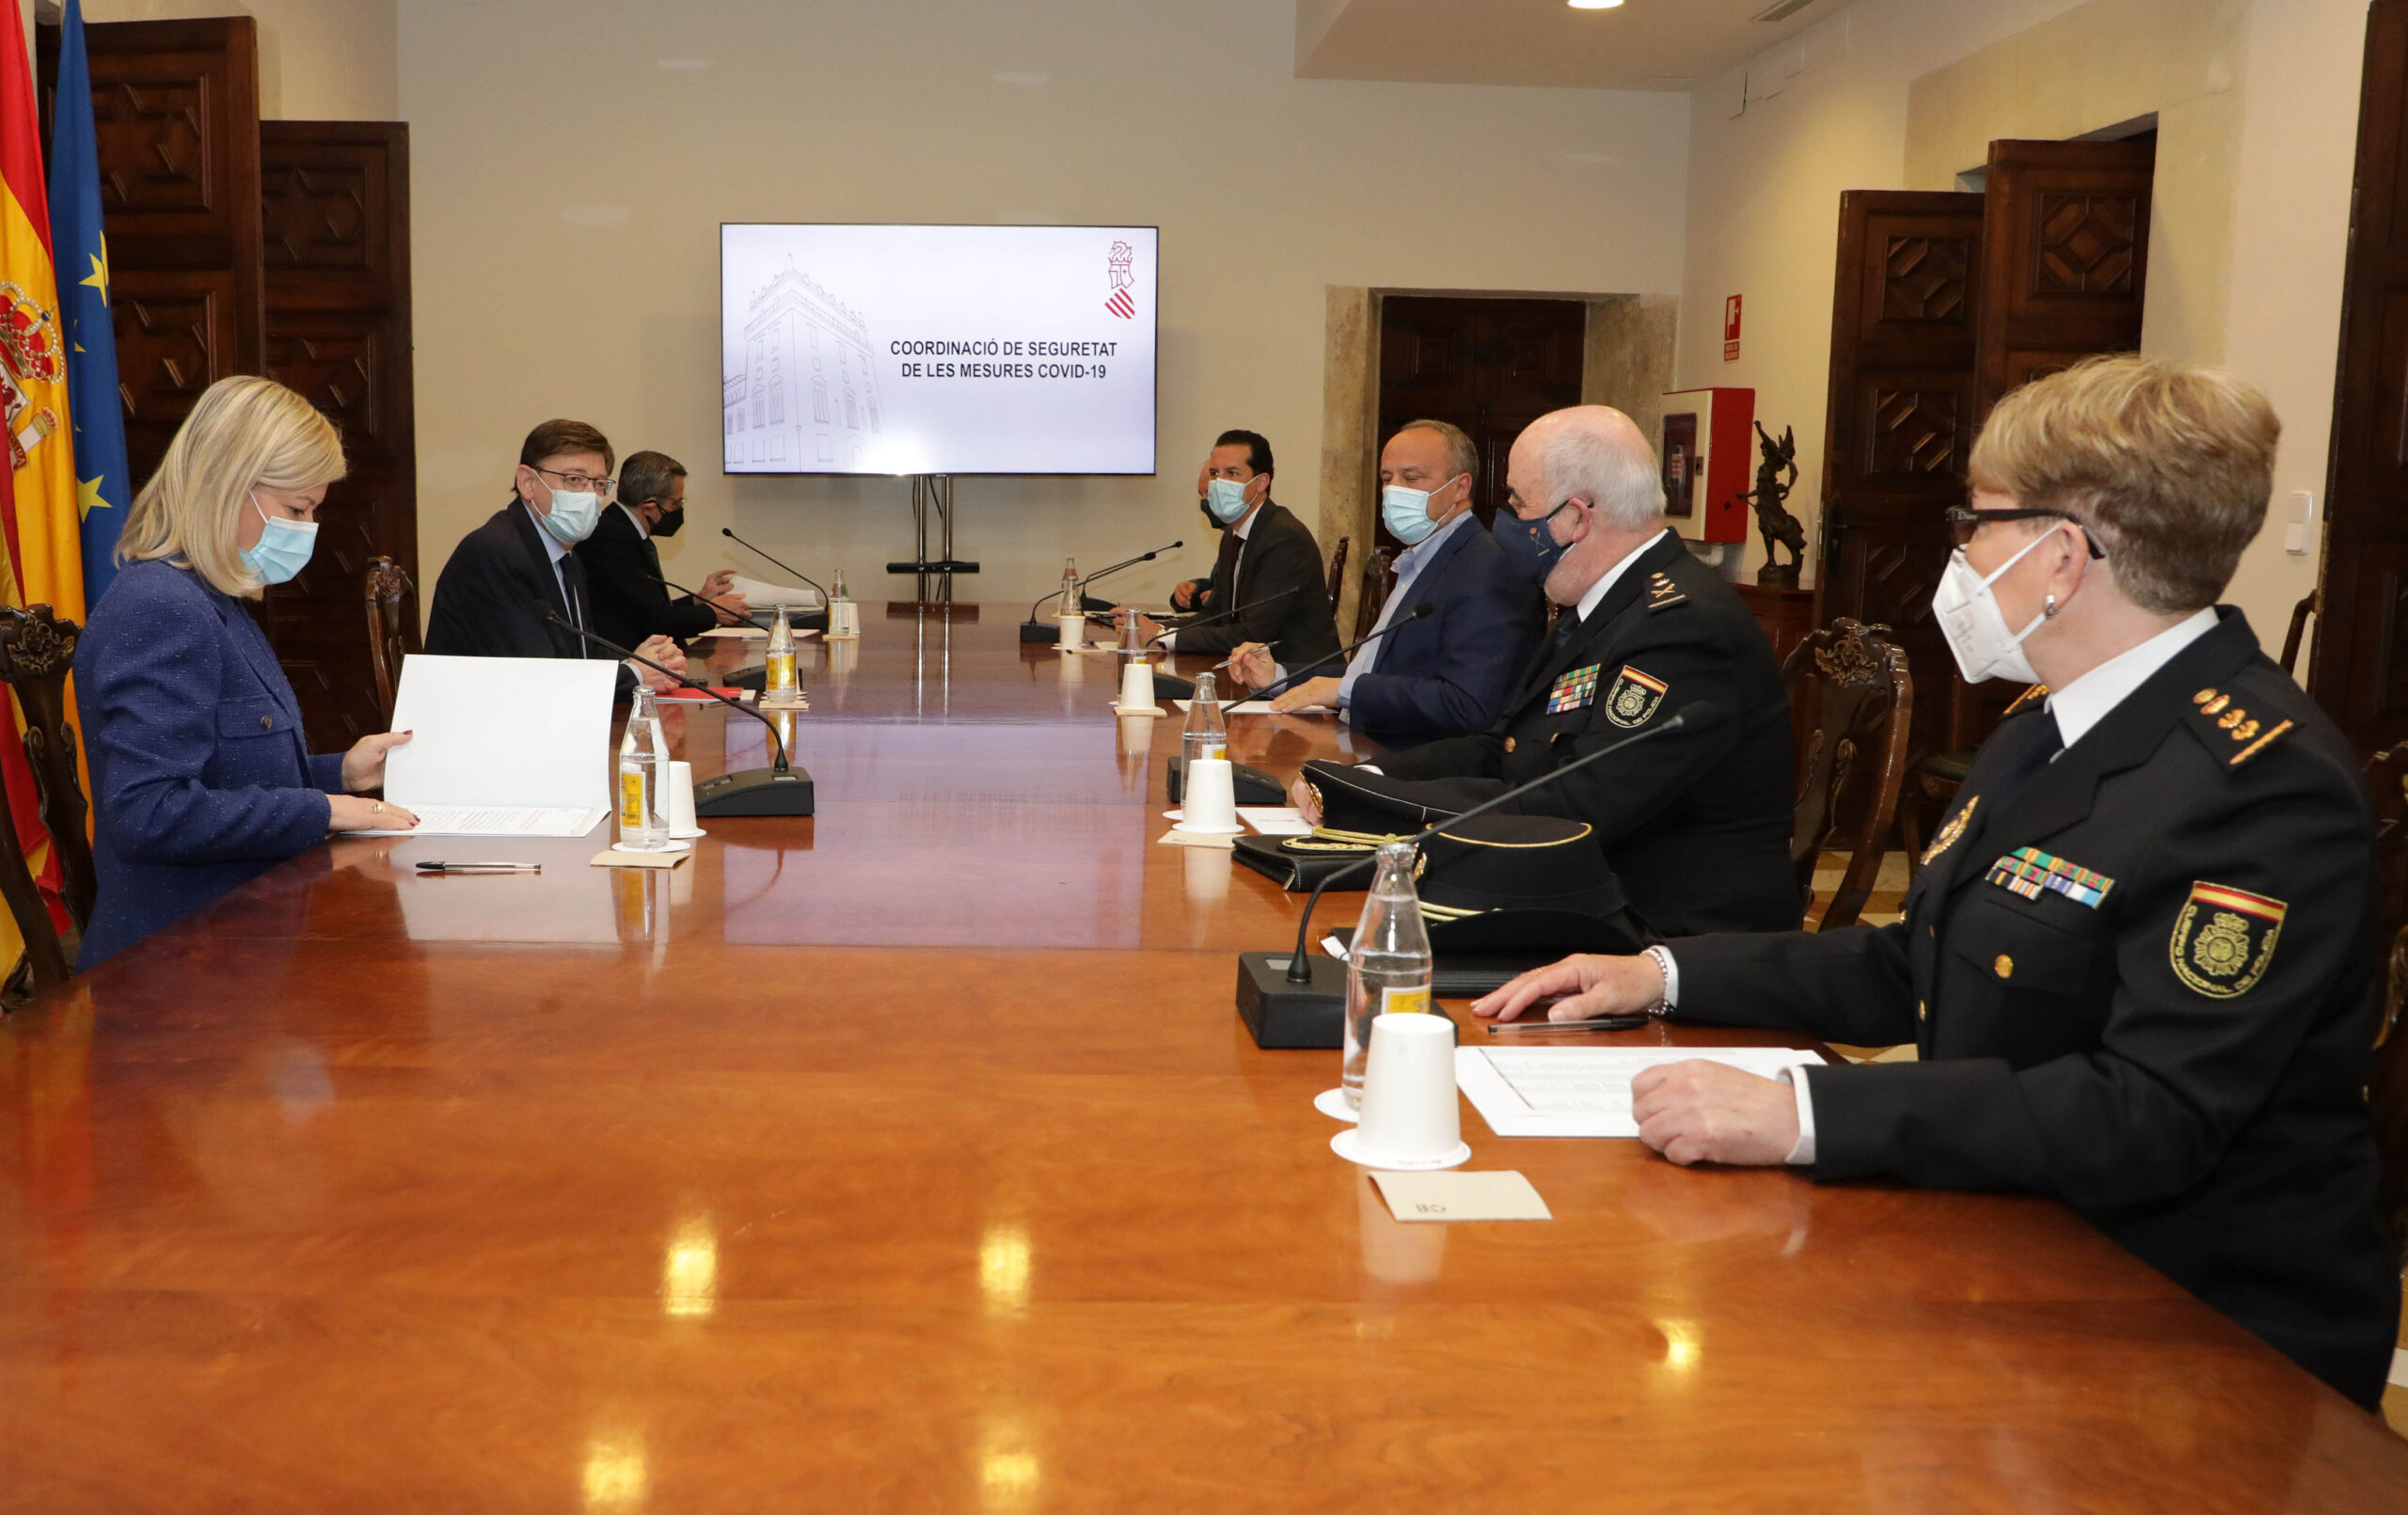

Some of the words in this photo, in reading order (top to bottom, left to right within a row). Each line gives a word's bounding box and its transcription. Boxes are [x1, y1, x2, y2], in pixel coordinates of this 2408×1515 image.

[890, 338, 999, 355] COORDINACIÓ
[1003, 341, 1023, 355] DE
[1028, 341, 1117, 356] SEGURETAT
[901, 363, 922, 377] DE
[927, 363, 955, 377] LES
[959, 363, 1034, 378] MESURES
[1038, 363, 1106, 379] COVID-19
